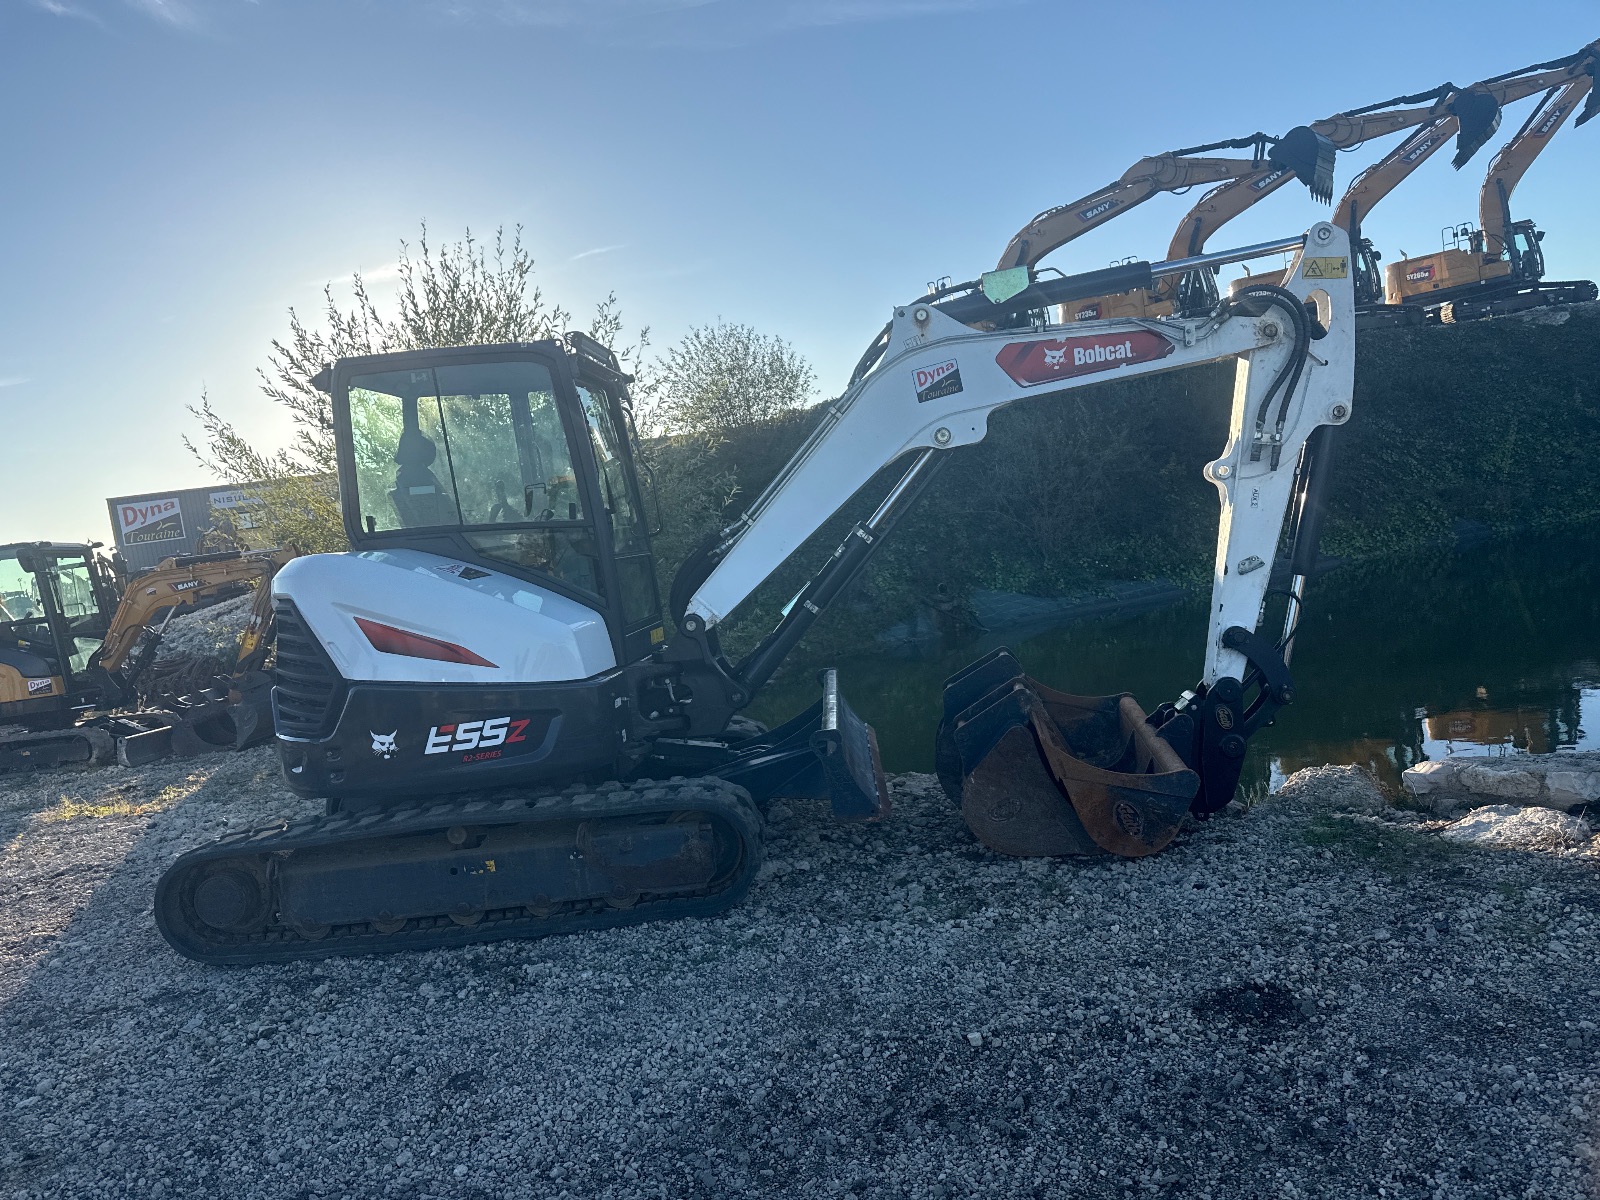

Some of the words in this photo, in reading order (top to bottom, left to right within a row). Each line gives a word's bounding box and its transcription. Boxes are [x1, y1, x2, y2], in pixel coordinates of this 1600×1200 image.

[1541, 109, 1561, 134] SANY
[1409, 139, 1433, 160] SANY
[1258, 170, 1282, 189] SANY
[1085, 201, 1110, 219] SANY
[1073, 340, 1133, 366] Bobcat
[916, 362, 955, 388] Dyna
[922, 384, 959, 400] Touraine
[122, 501, 175, 527] Dyna
[128, 529, 180, 543] Touraine
[177, 580, 199, 590] SANY
[30, 680, 50, 690] Dyna
[462, 749, 502, 762] R2-SERIES
